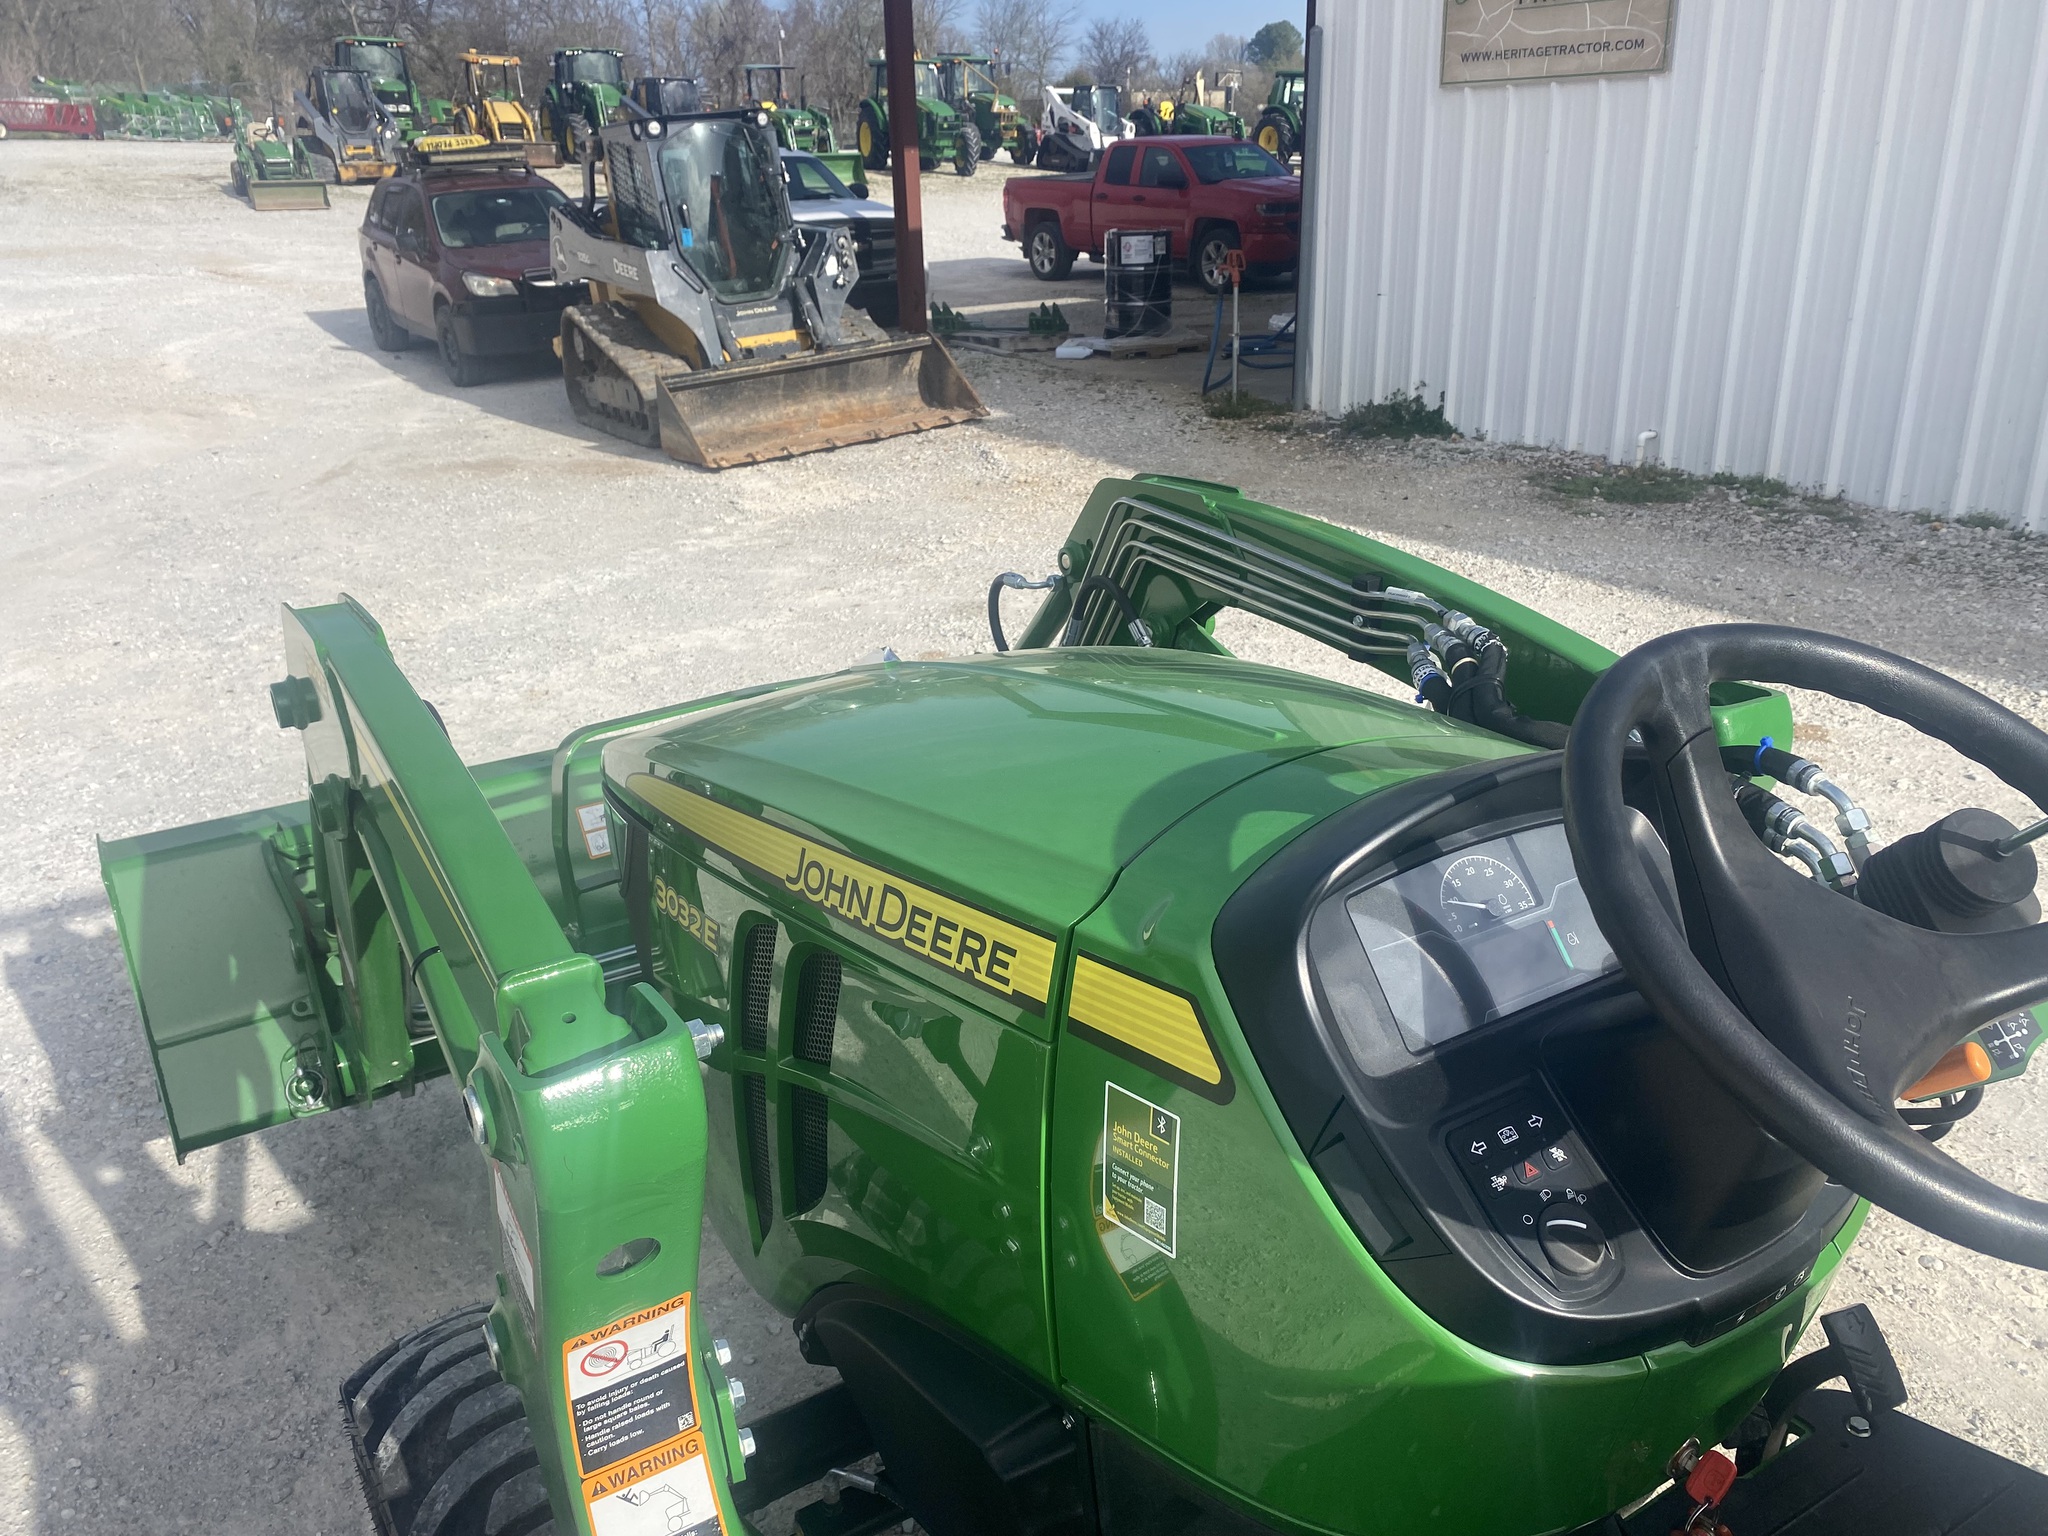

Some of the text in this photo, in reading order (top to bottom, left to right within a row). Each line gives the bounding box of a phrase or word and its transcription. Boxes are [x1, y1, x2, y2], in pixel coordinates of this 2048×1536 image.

[1460, 38, 1645, 63] WWW.HERITAGETRACTOR.COM
[613, 257, 639, 281] DEERE
[1451, 878, 1461, 888] 15
[1465, 866, 1475, 876] 20
[1483, 867, 1494, 877] 25
[1503, 879, 1514, 888] 30
[653, 874, 719, 957] 3032E
[1451, 912, 1457, 920] 5
[1517, 900, 1528, 910] 35
[785, 847, 1019, 992] JOHN DEERE
[1113, 1121, 1158, 1154] John Deere
[1113, 1132, 1170, 1169] Smart Connector
[1112, 1145, 1143, 1167] INSTALLED
[1112, 1162, 1154, 1192] Connect your phone
[1117, 1175, 1127, 1184] your
[1127, 1180, 1144, 1195] tractor.
[590, 1297, 685, 1341] WARNING
[587, 1392, 607, 1406] avoid
[608, 1385, 630, 1398] injury
[639, 1373, 660, 1385] death
[660, 1360, 685, 1376] caused
[576, 1389, 634, 1417] by falling loads:
[582, 1419, 593, 1427] Do
[595, 1413, 607, 1422] not
[608, 1401, 632, 1417] handle
[633, 1392, 654, 1405] round
[583, 1402, 651, 1433] large square bales.
[585, 1401, 671, 1442] Handle raised loads with
[586, 1433, 615, 1448] caution.
[587, 1429, 645, 1456] Carry loads low.
[607, 1438, 699, 1488] WARNING
